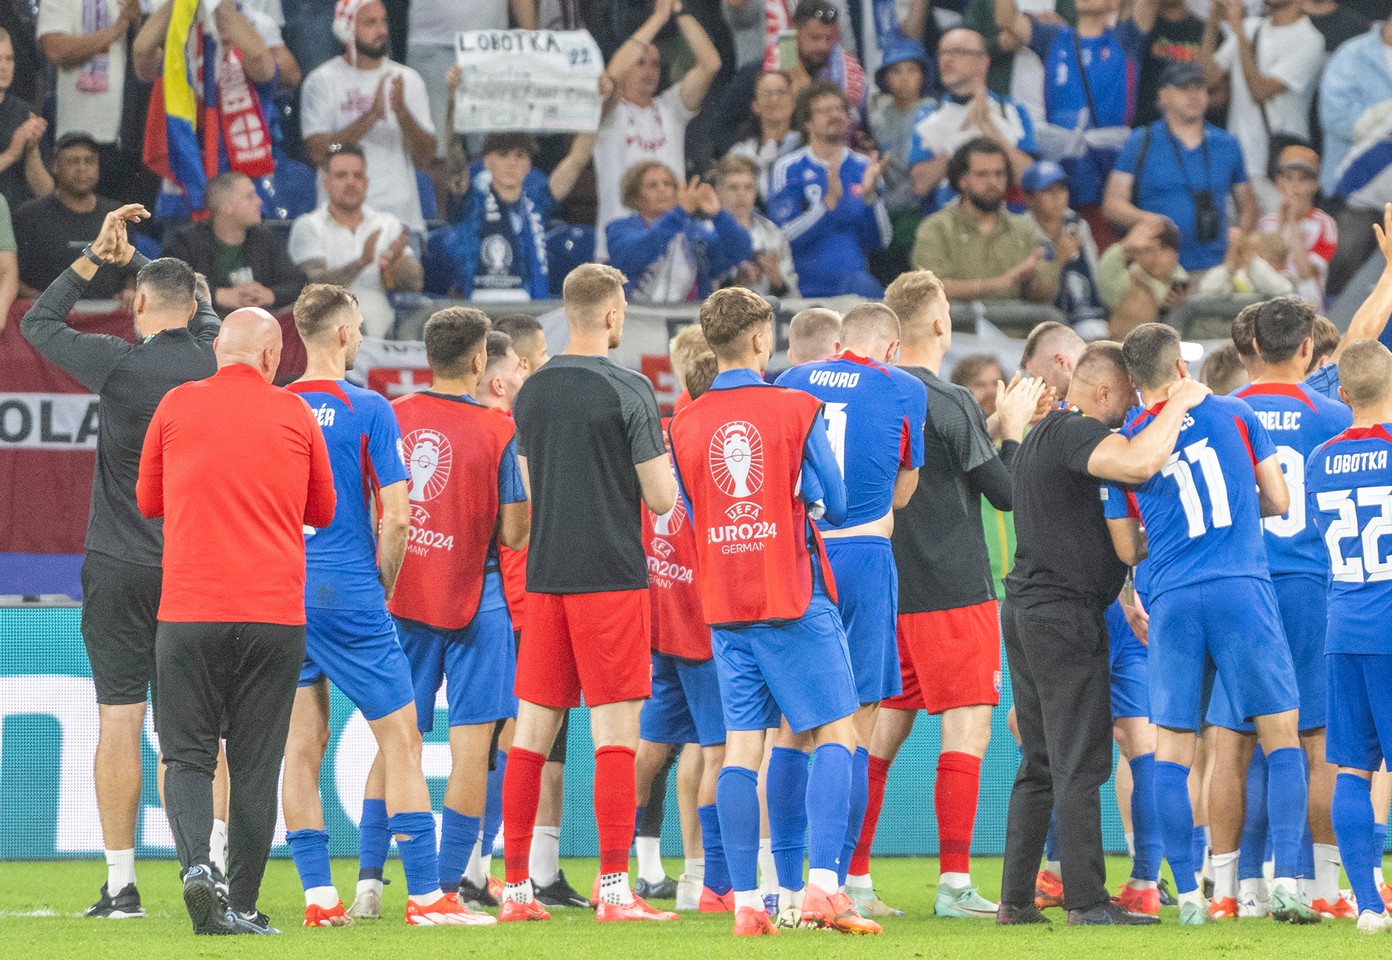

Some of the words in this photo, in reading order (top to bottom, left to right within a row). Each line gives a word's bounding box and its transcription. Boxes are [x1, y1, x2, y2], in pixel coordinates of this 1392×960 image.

[458, 31, 561, 53] LOBOTKA
[1325, 449, 1388, 475] LOBOTKA
[1161, 437, 1233, 539] 11
[727, 504, 760, 520] UEFA
